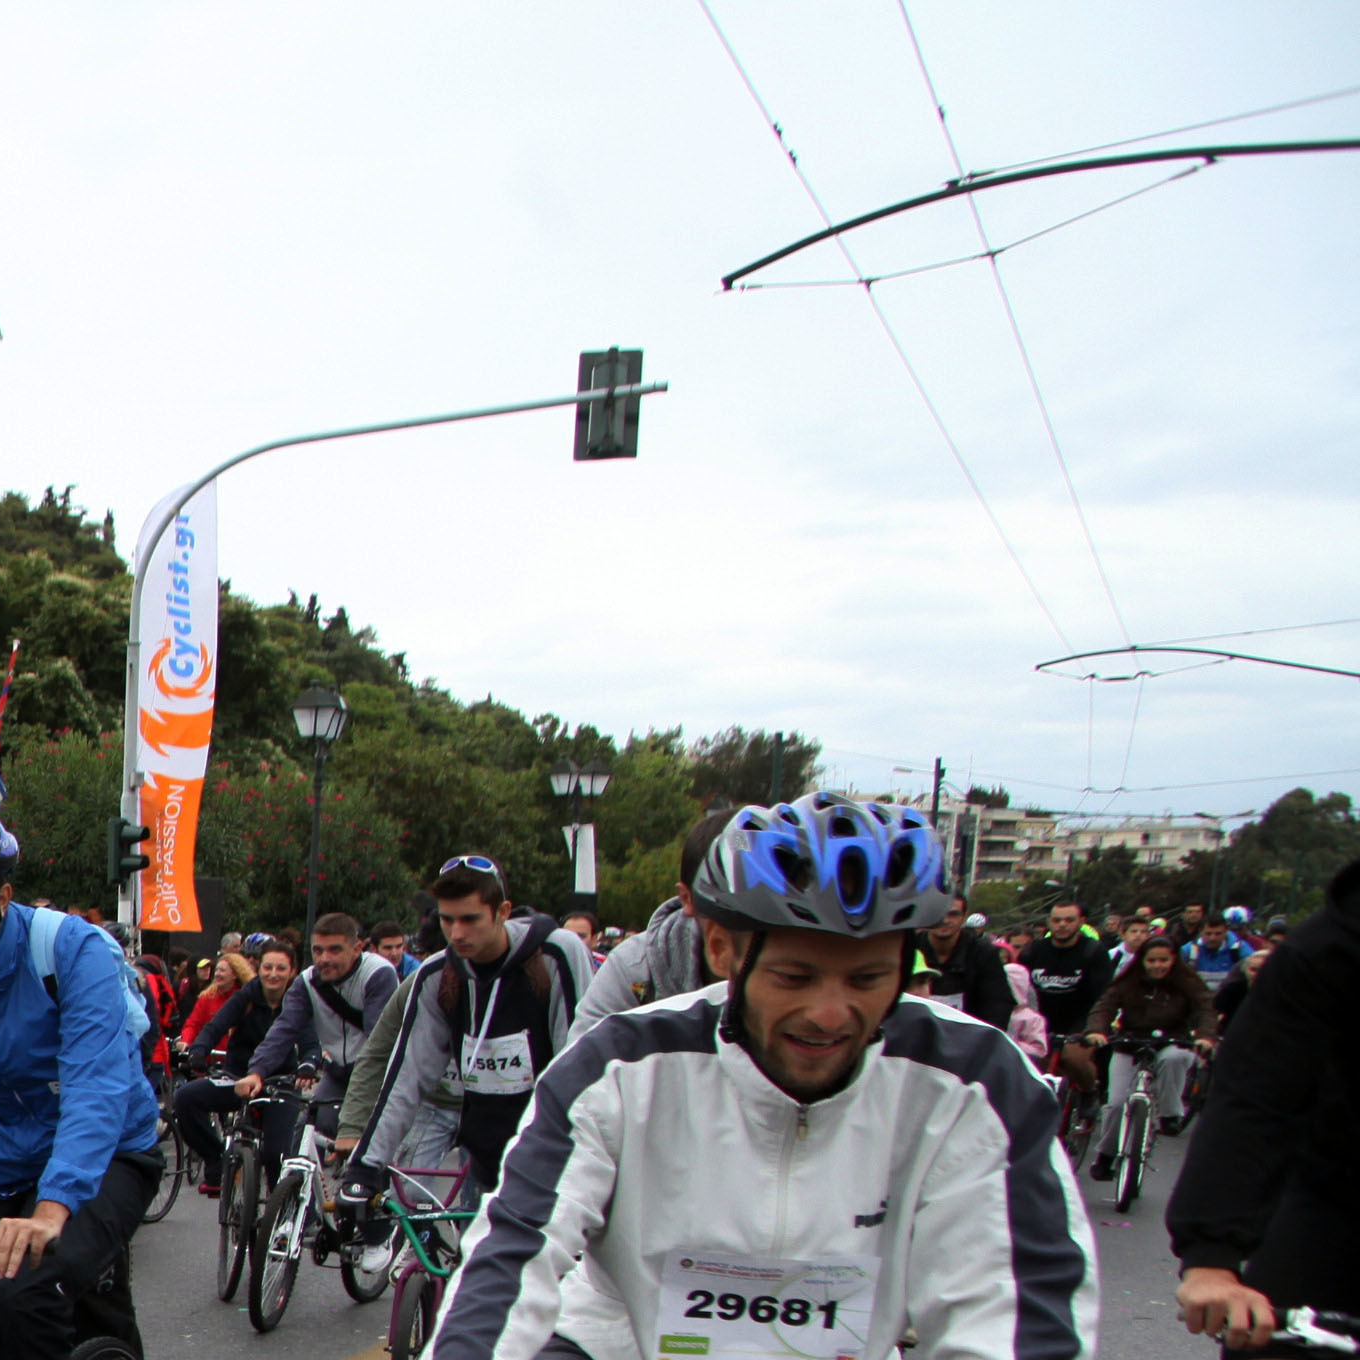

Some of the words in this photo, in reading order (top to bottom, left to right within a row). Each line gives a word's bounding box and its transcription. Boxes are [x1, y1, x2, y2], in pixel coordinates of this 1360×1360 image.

[163, 784, 187, 876] PASSION
[162, 882, 182, 925] OUR
[684, 1290, 838, 1330] 29681
